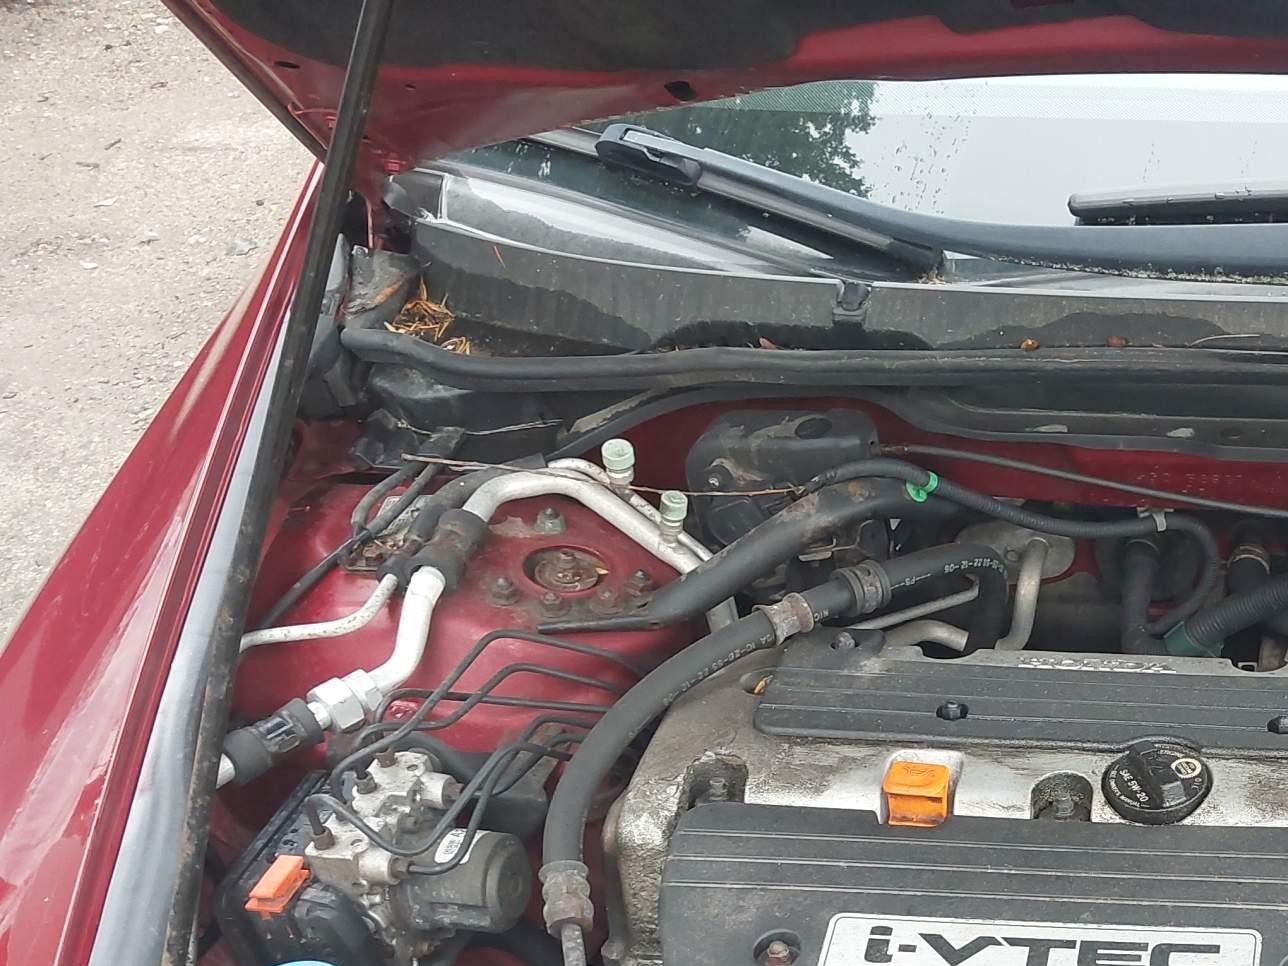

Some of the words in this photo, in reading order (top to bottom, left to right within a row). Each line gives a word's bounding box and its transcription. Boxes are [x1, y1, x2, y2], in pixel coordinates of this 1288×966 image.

[1119, 768, 1133, 783] SAE
[1127, 779, 1151, 803] 5W-20
[1191, 776, 1204, 791] OIL
